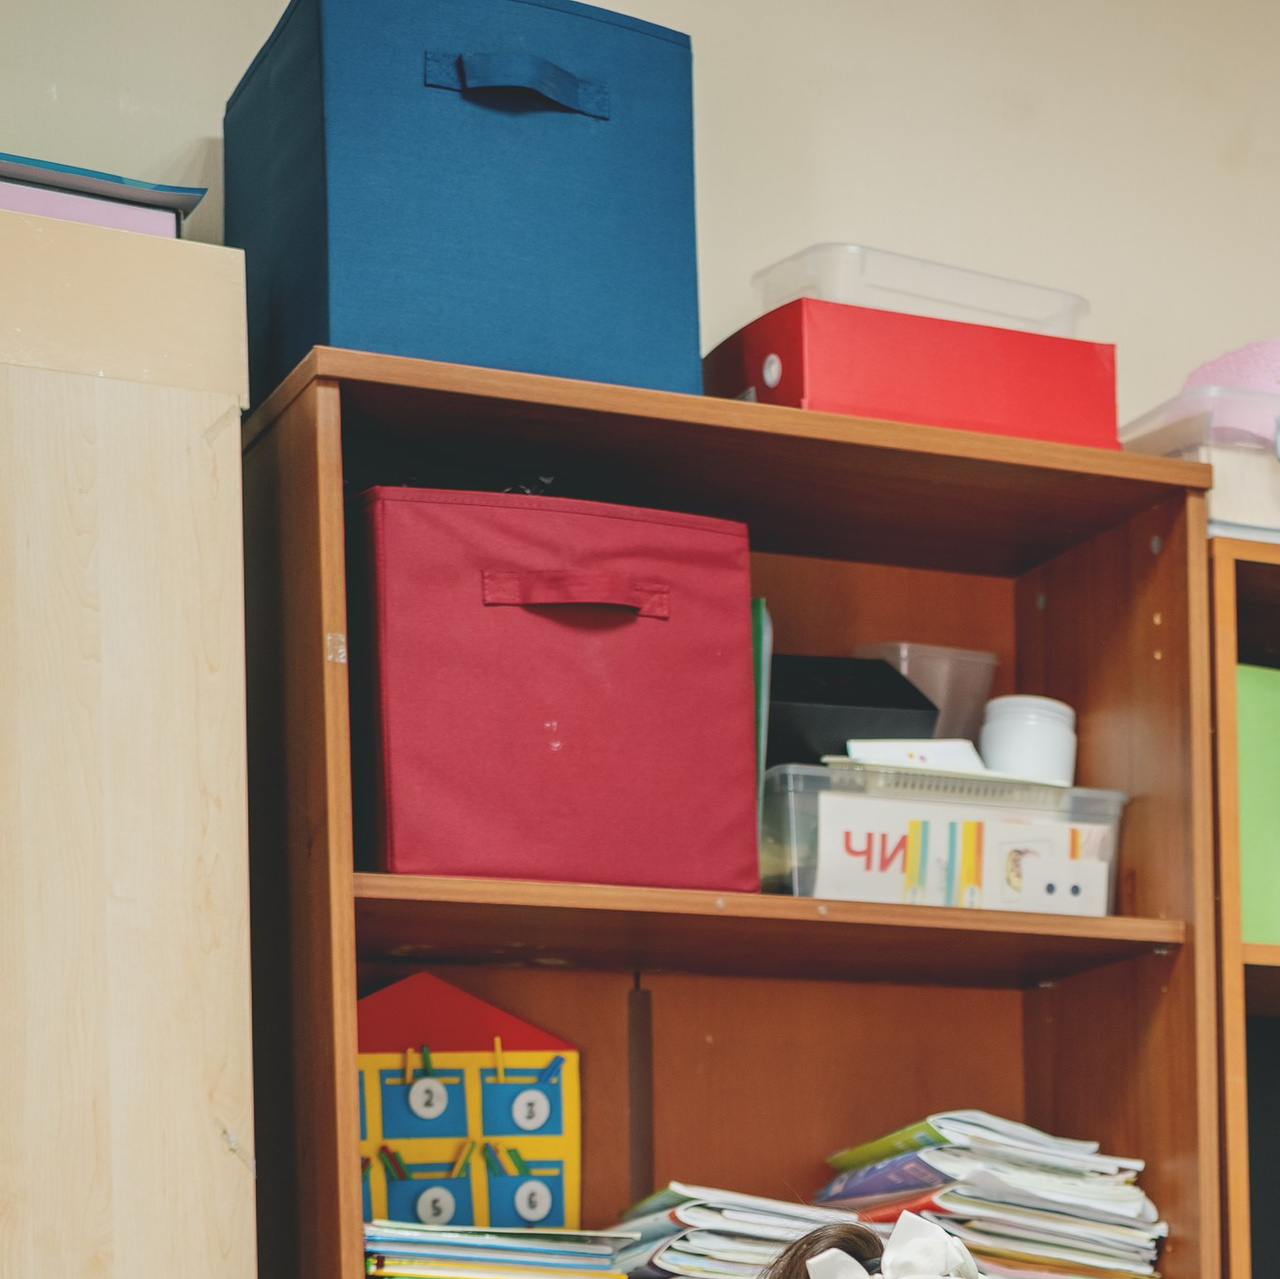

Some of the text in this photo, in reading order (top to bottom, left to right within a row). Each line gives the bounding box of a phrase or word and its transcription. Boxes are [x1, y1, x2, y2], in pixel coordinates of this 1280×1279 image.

[424, 1088, 536, 1120] 2 3
[430, 1190, 537, 1218] 5 6
